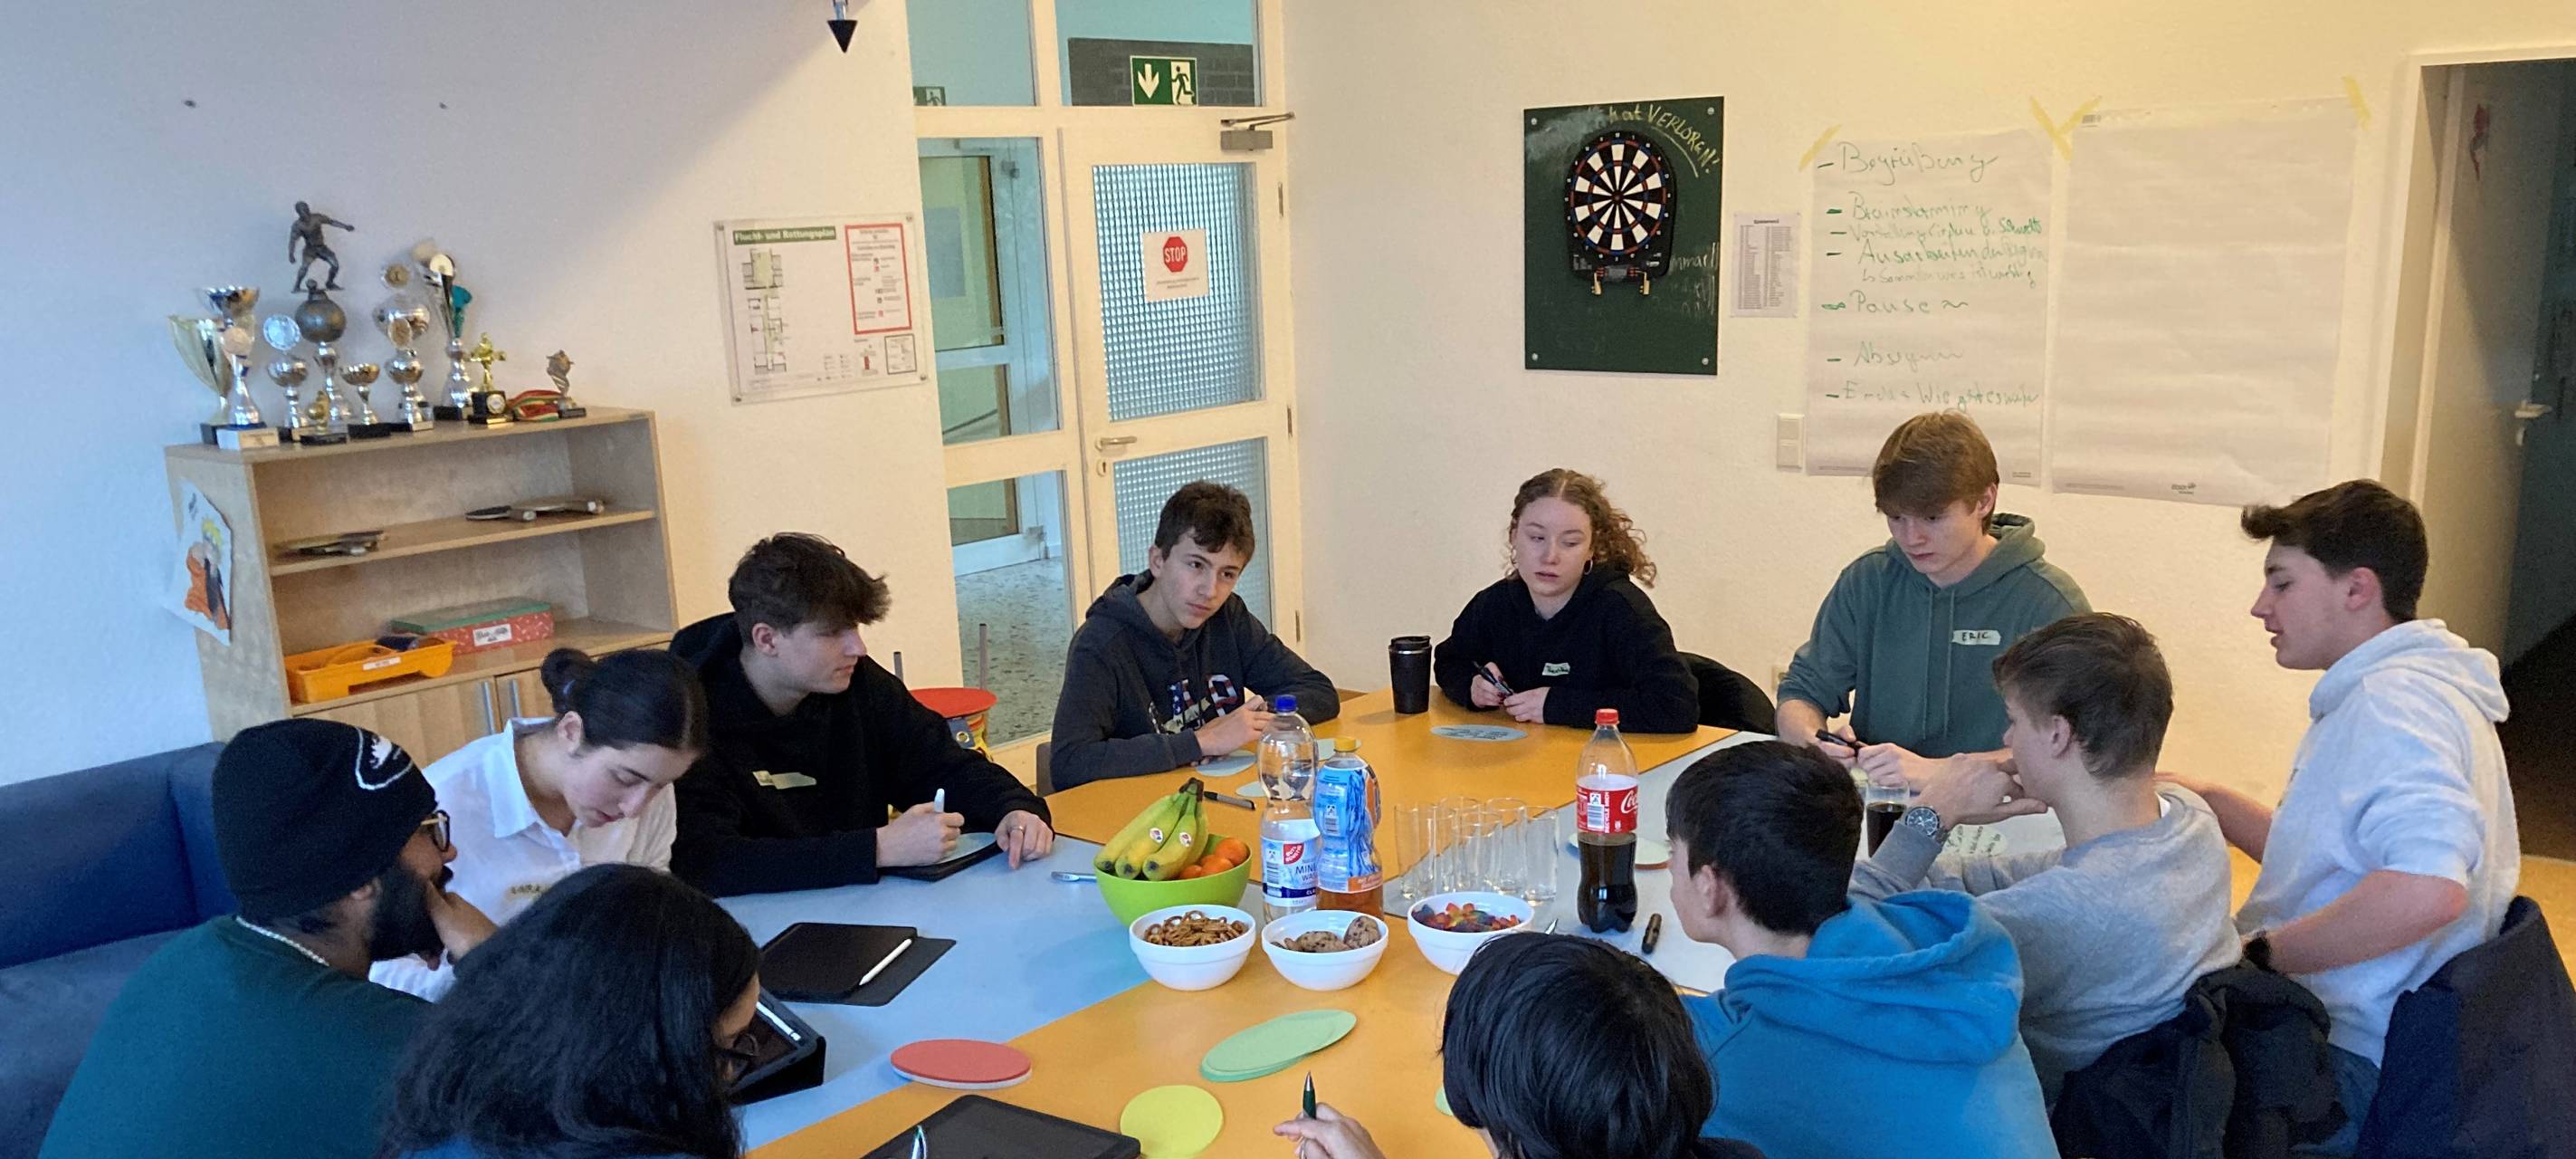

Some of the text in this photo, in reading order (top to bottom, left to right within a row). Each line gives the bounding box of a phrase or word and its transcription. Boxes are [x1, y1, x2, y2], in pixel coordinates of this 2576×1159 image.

[1164, 246, 1187, 263] STOP
[1850, 290, 1930, 313] Pause
[1961, 631, 1989, 642] ERIC
